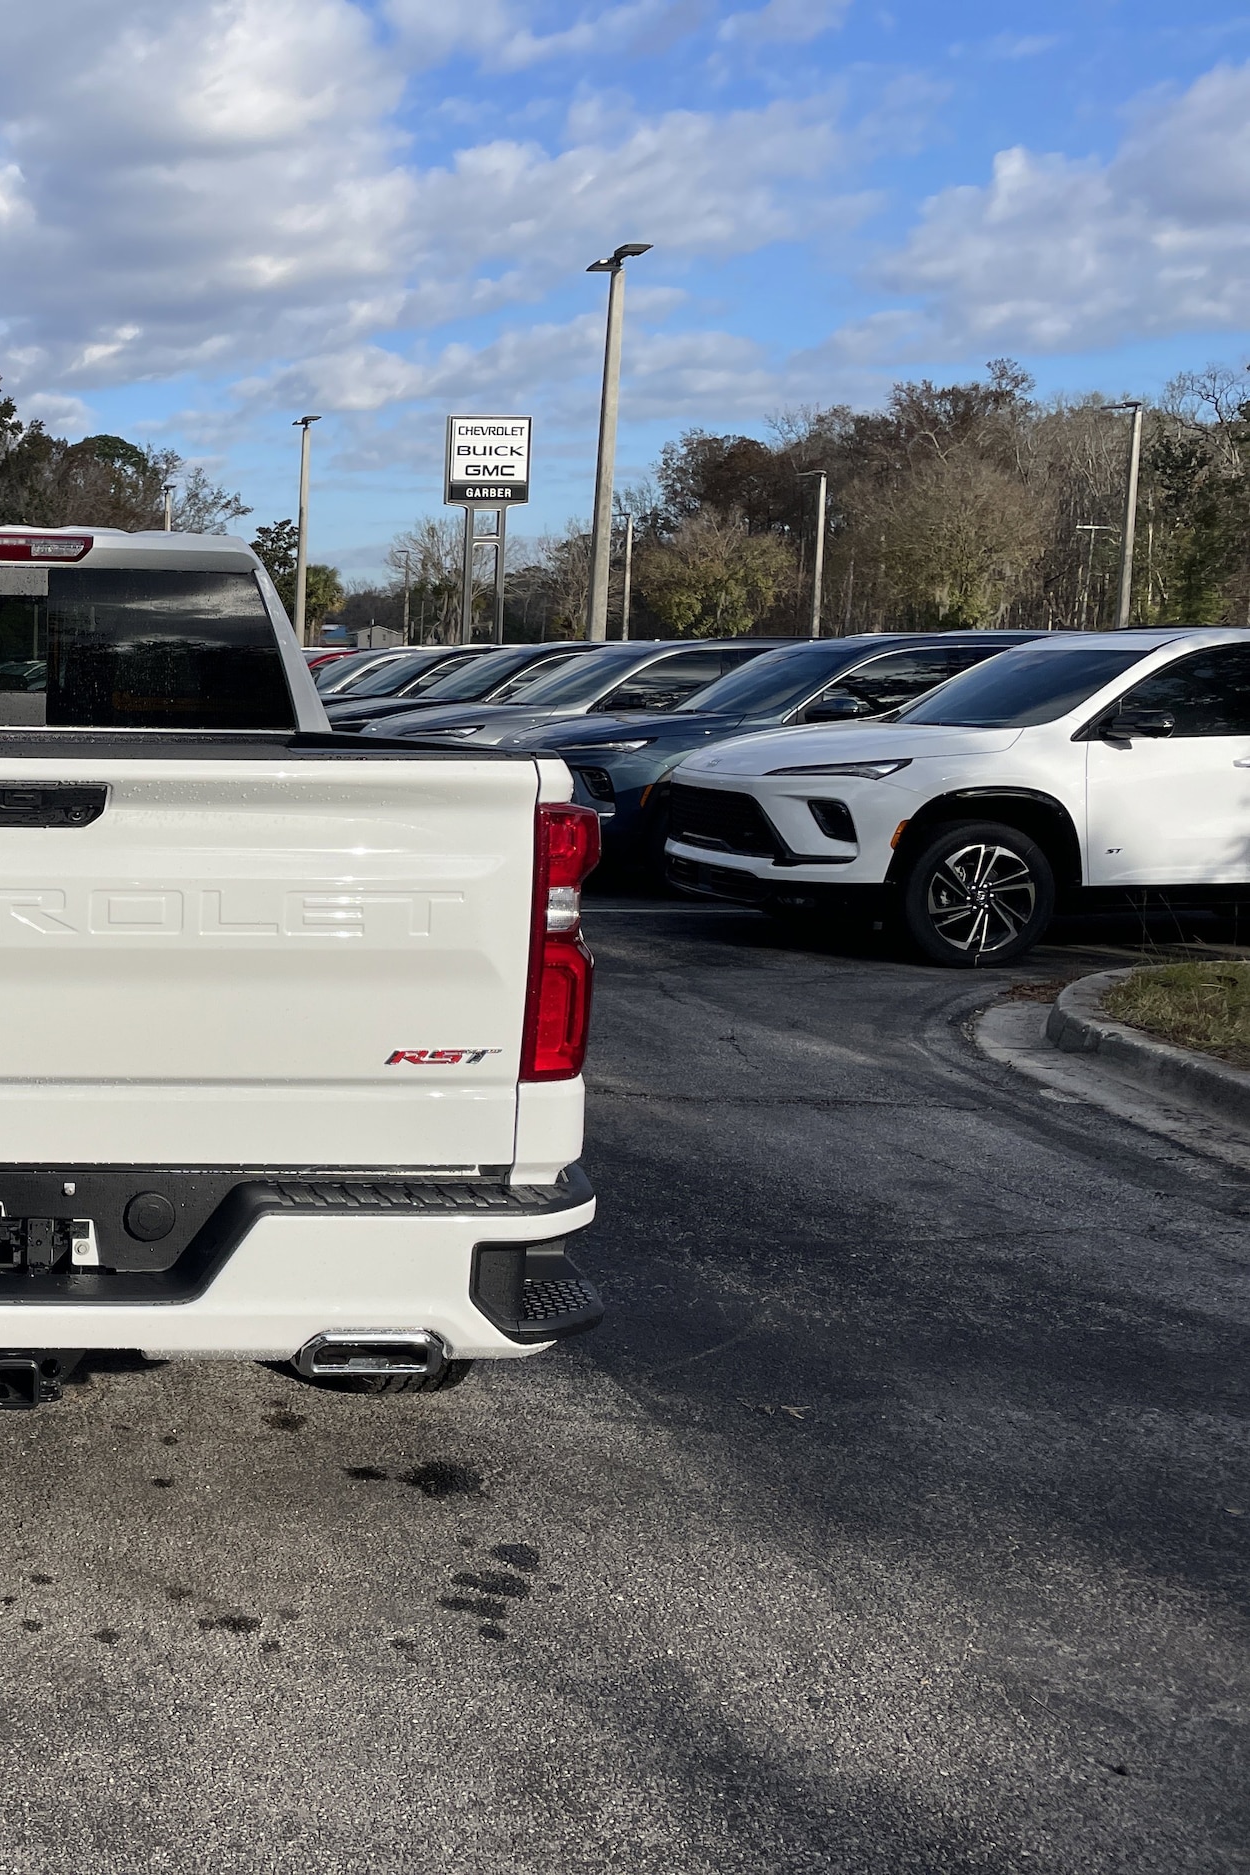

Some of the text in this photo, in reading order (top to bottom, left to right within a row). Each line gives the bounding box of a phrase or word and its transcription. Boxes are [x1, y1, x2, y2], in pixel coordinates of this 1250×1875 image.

[458, 426, 525, 436] CHEVROLET
[457, 446, 525, 456] BUICK
[465, 465, 515, 476] GMC
[466, 488, 512, 498] GARBER
